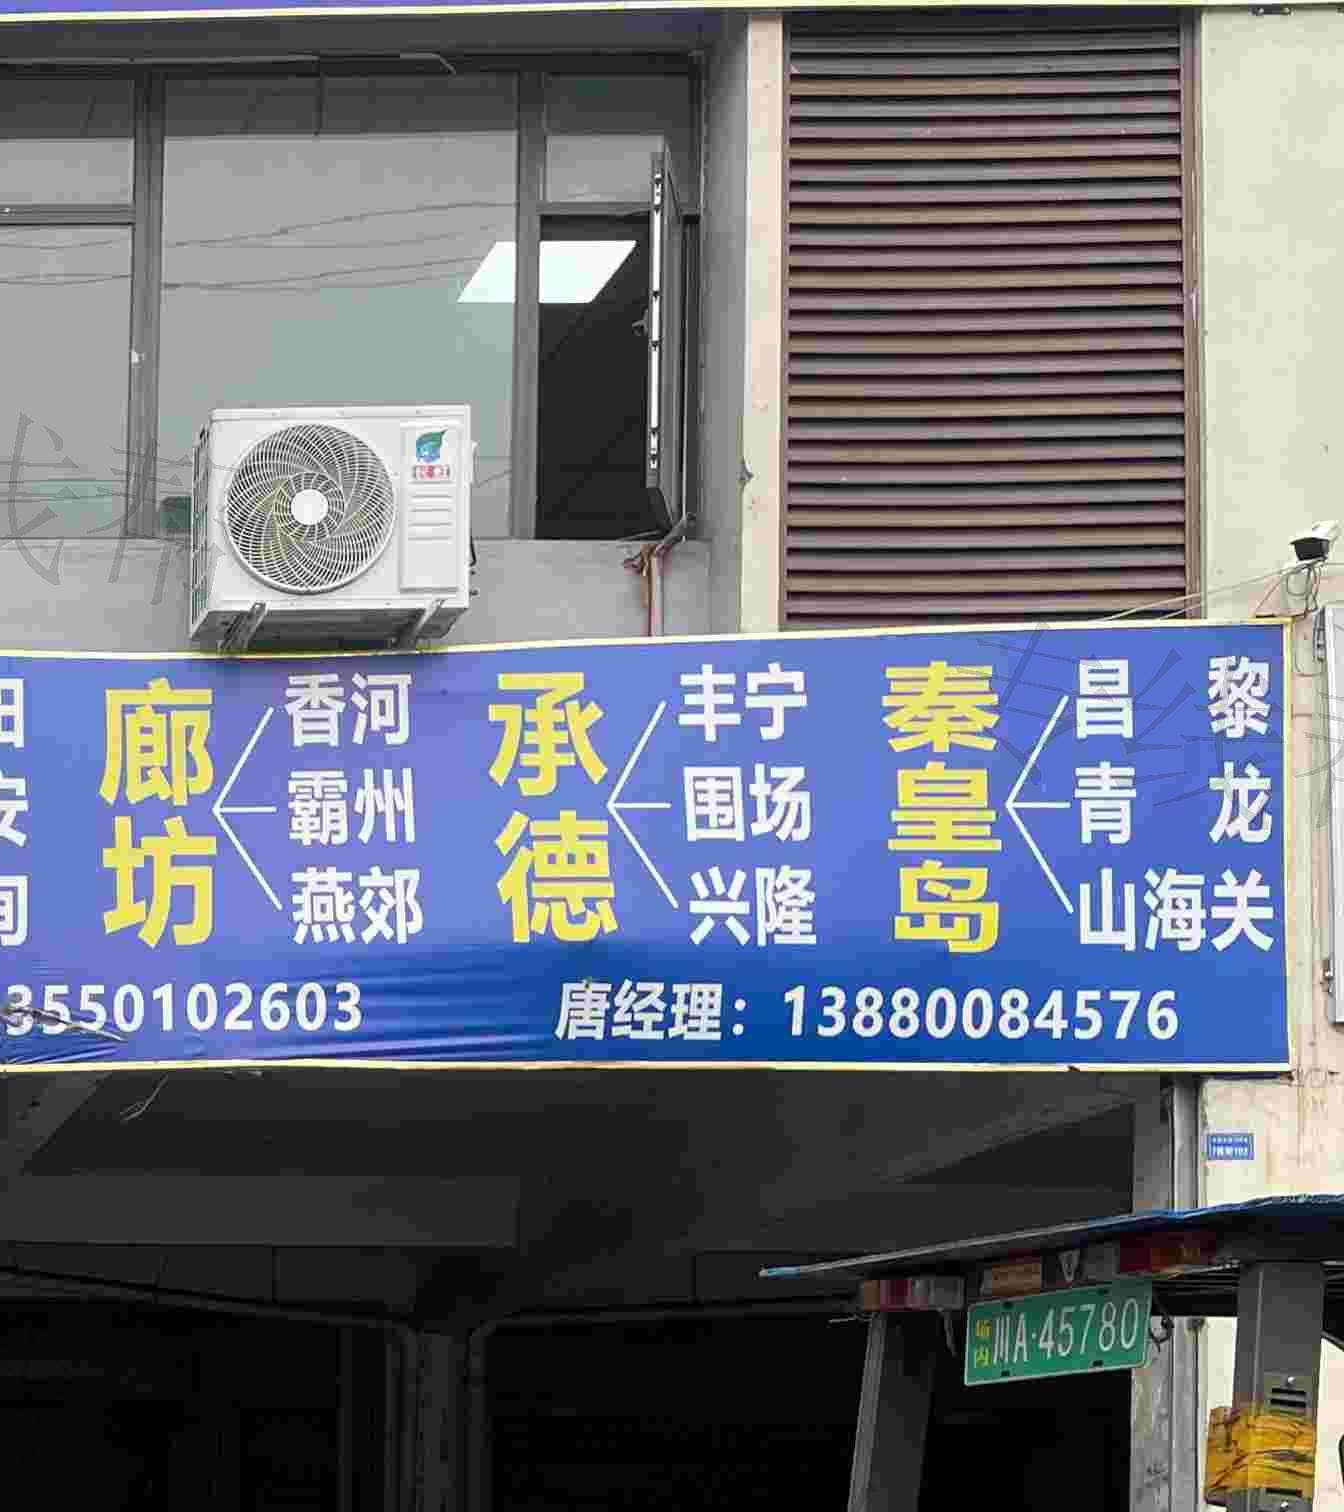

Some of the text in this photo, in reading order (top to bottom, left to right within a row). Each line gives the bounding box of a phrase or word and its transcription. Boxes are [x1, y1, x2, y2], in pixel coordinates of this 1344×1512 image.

[285, 674, 413, 746] 香河
[677, 662, 808, 743] 丰宁
[98, 677, 217, 950] 廊坊
[287, 769, 416, 846] 霸州
[488, 672, 618, 945] 承德
[683, 764, 813, 843] 围场
[881, 661, 1002, 953] 秦皇岛
[292, 867, 424, 946] 燕郊
[688, 866, 817, 948] 兴隆
[1077, 869, 1274, 952] 山海关
